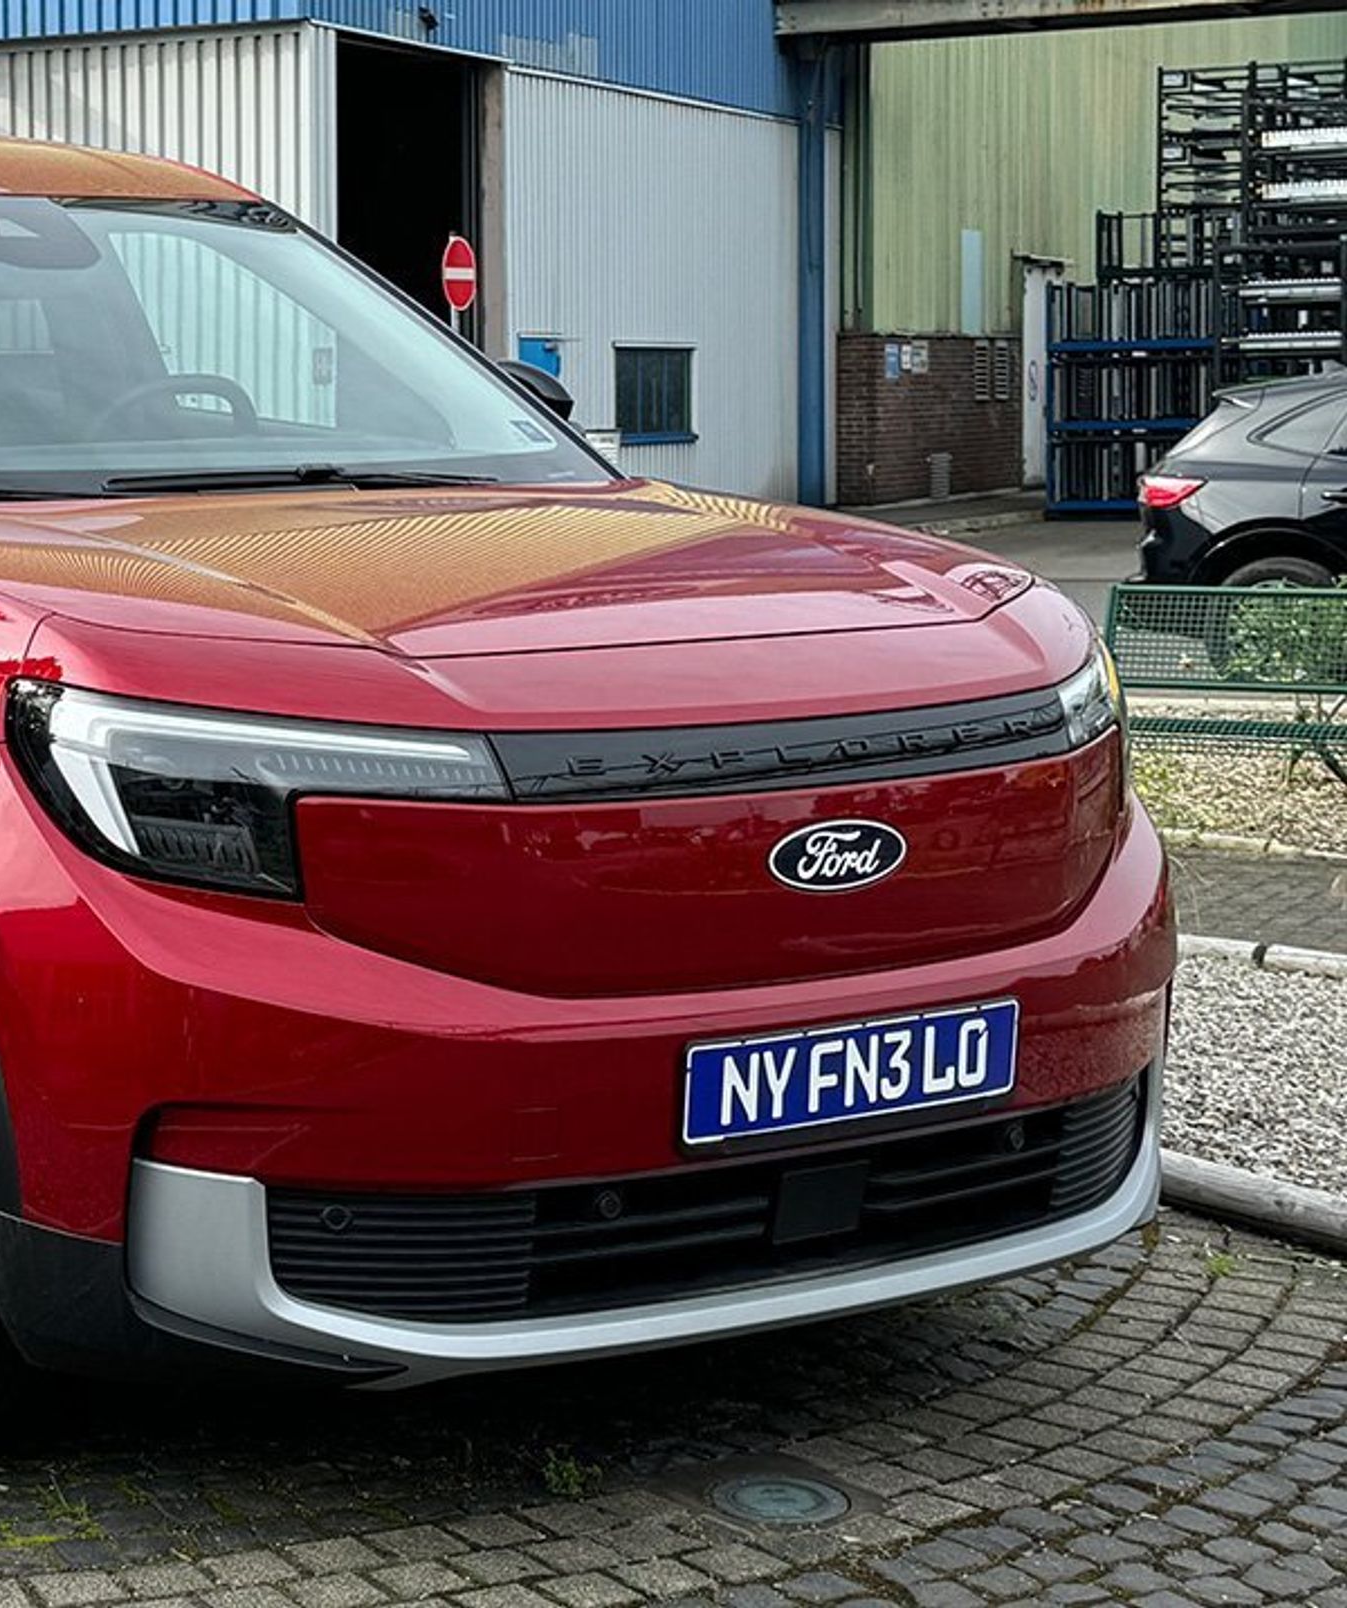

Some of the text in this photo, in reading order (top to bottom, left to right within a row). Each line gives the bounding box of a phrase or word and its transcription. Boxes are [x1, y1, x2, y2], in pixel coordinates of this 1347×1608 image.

[797, 830, 882, 880] Ford
[720, 1047, 797, 1126] NY
[808, 1029, 913, 1113] FN3
